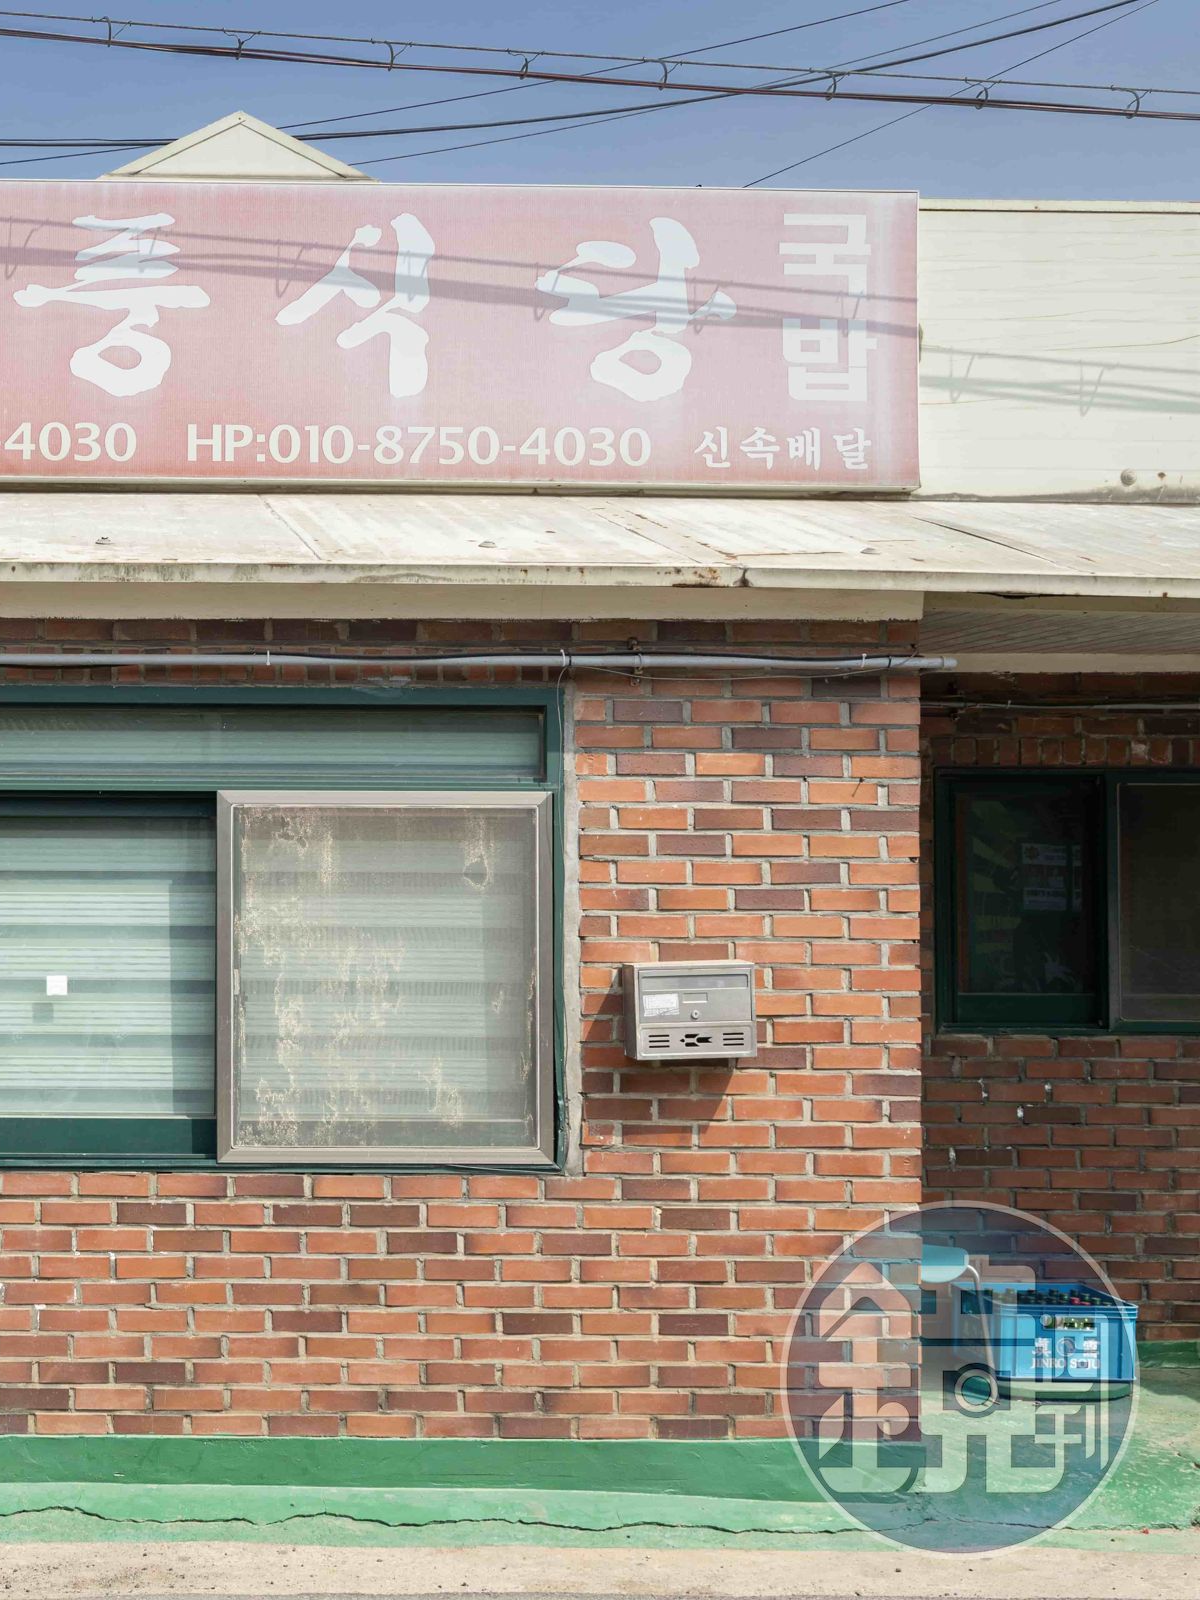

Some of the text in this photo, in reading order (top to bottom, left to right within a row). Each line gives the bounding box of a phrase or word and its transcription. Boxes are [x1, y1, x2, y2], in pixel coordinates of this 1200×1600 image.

[779, 213, 877, 402] 국밥
[186, 423, 652, 467] HP:010-8750-4030
[693, 425, 873, 472] 신속배달
